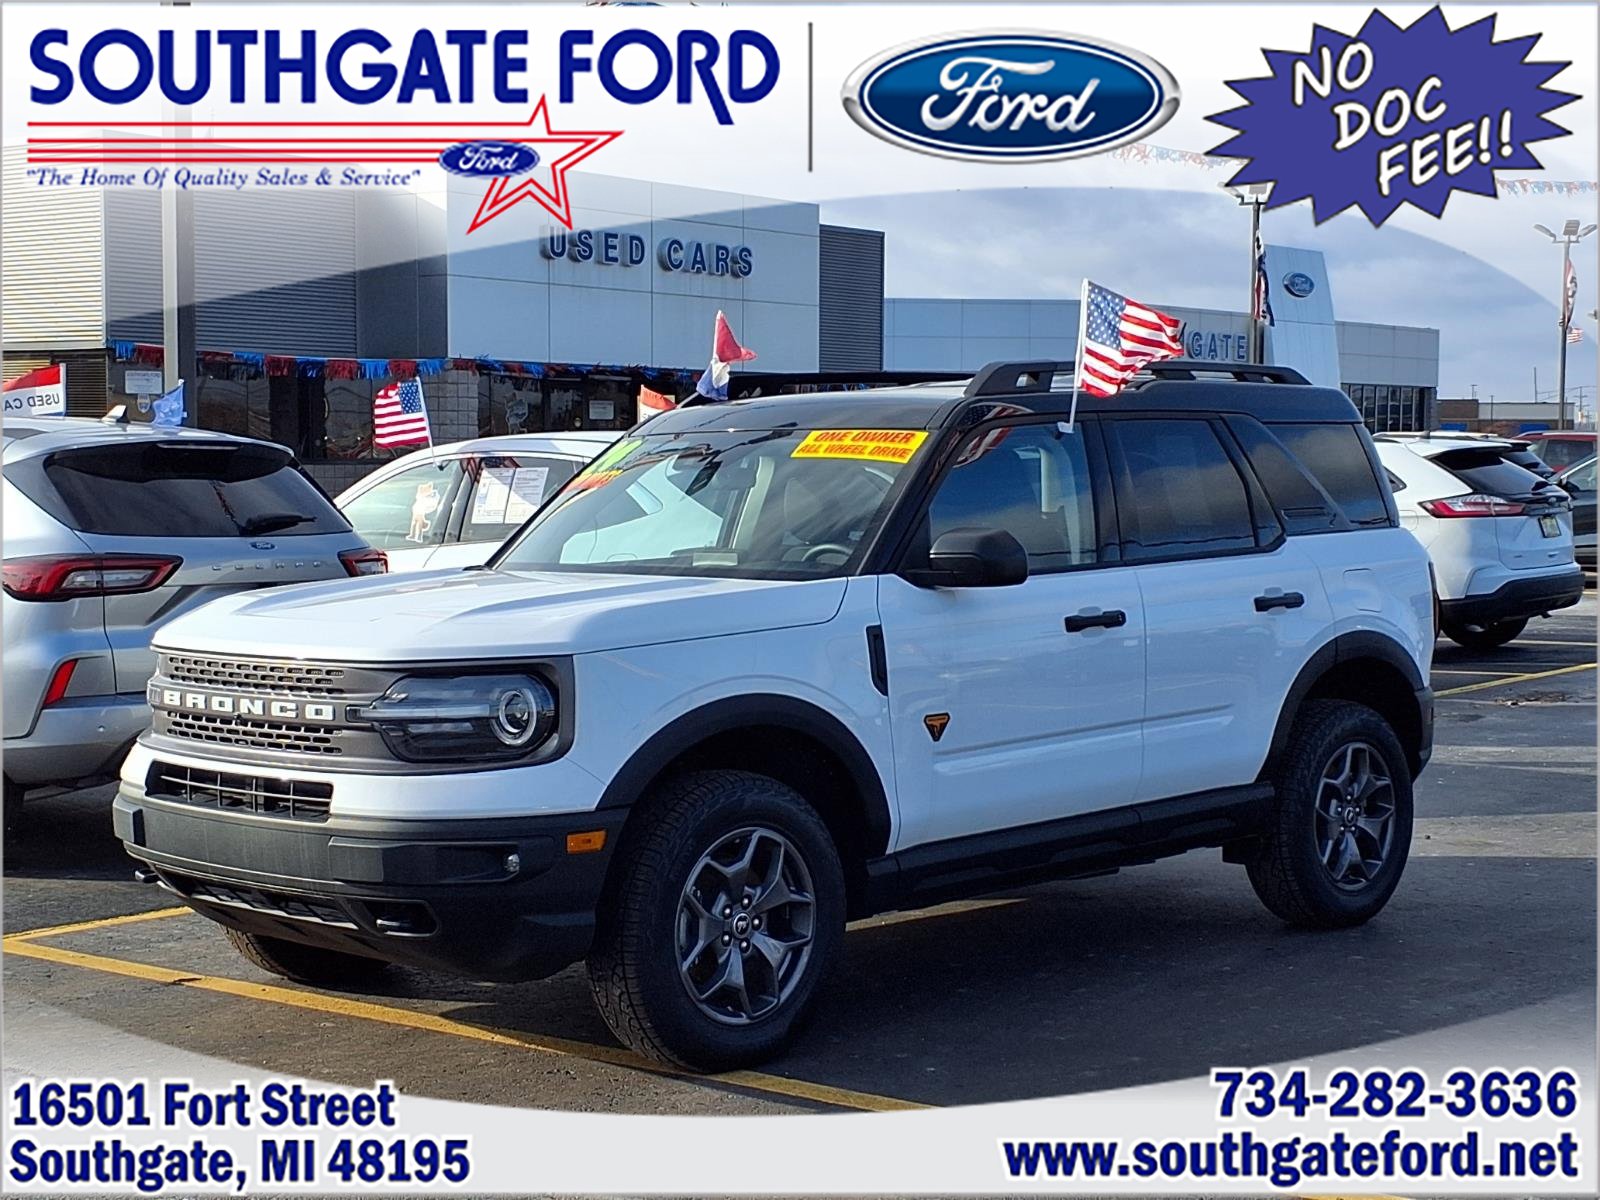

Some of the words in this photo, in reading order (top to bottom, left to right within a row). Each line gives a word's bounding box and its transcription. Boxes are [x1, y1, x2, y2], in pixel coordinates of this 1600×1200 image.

[547, 230, 645, 266] USED
[667, 239, 753, 277] CARS
[814, 431, 852, 443] ONE
[851, 431, 916, 444] OWNER
[797, 444, 823, 454] ALL
[823, 444, 867, 456] WHEEL
[867, 446, 913, 459] DRIVE
[163, 689, 335, 721] BRONCO
